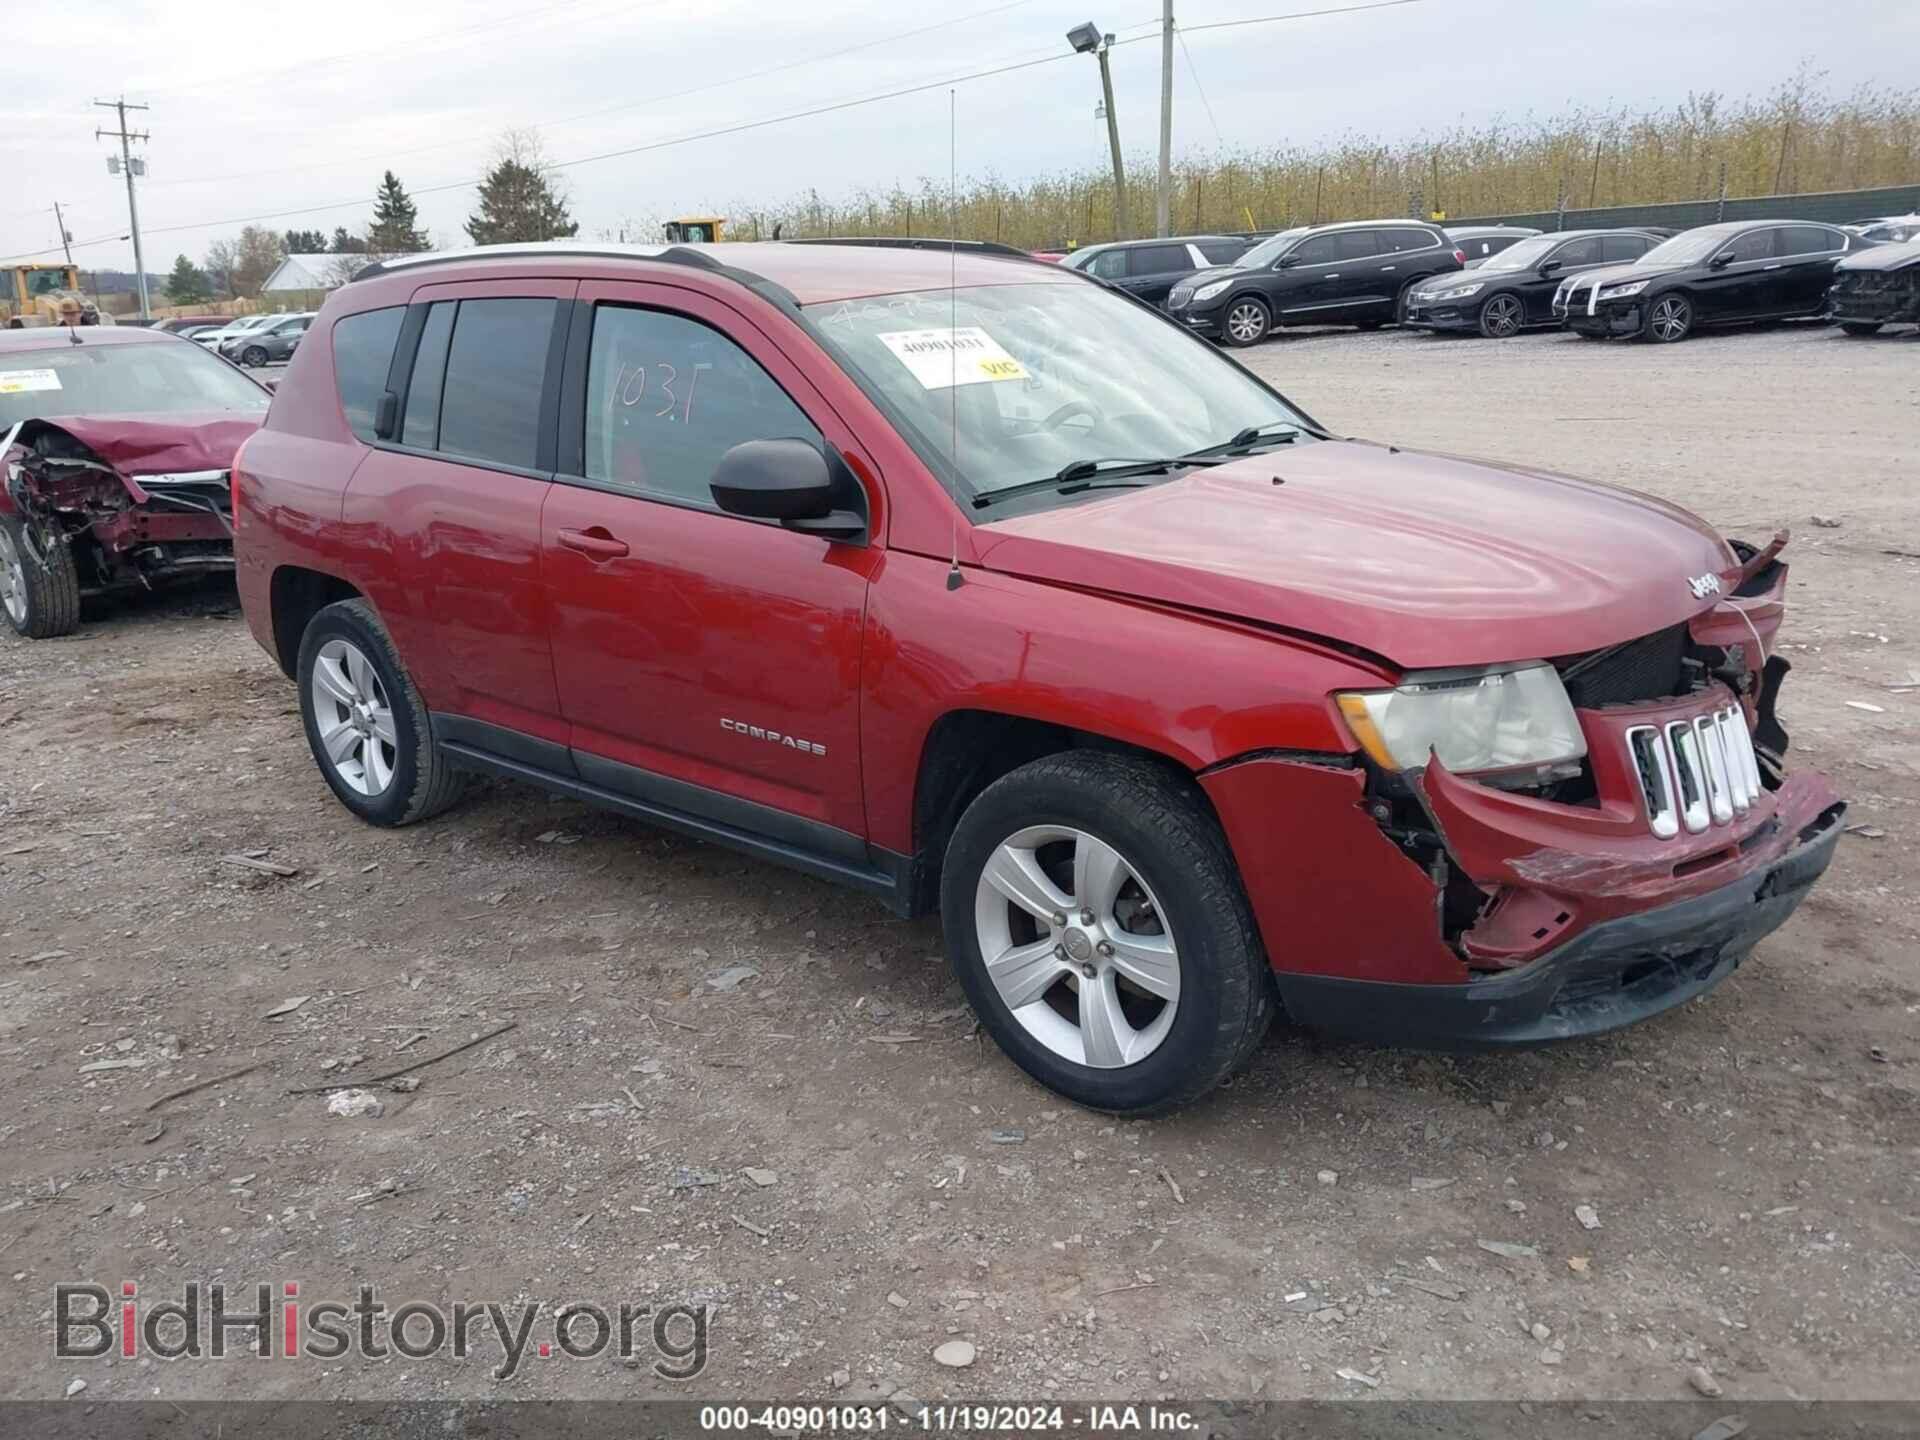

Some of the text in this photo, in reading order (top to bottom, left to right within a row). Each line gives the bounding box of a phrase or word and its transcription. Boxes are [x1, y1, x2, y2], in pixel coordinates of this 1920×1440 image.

[903, 337, 985, 353] 40901031
[980, 361, 1020, 375] VIC
[1687, 572, 1721, 599] Jeep
[719, 717, 827, 756] COMPASS
